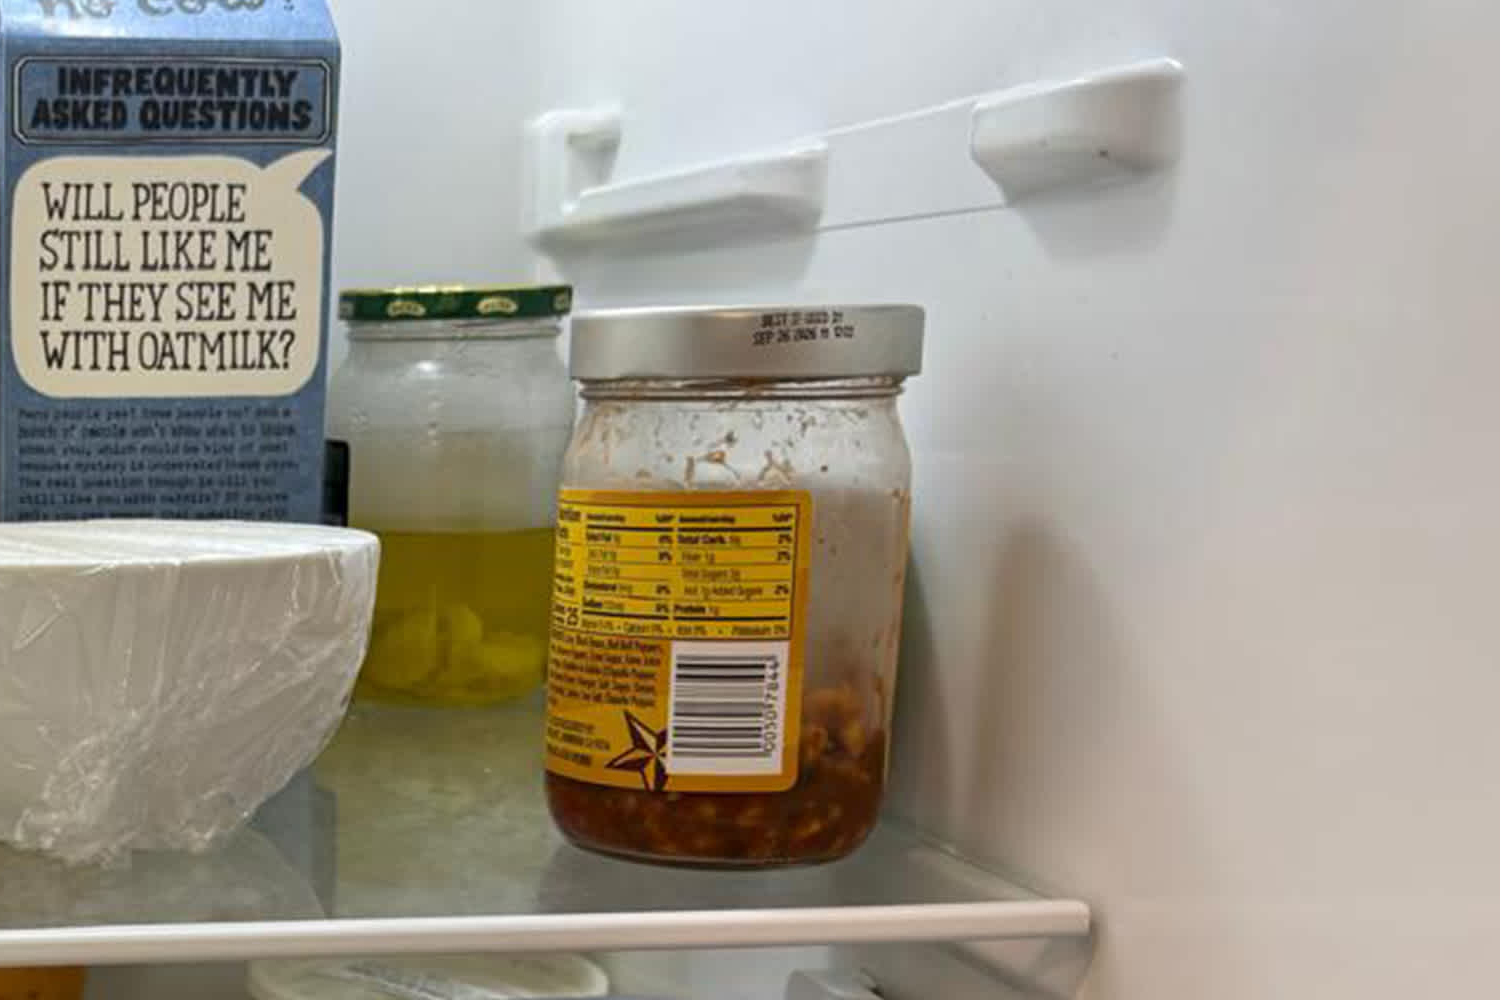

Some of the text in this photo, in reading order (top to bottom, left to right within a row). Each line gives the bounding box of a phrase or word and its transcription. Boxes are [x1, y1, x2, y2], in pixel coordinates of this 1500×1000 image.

[57, 66, 300, 98] INFREQUENTLY
[31, 99, 312, 131] ASKED QUESTIONS
[41, 182, 247, 223] WILL PEOPLE
[39, 229, 130, 272] STILL
[140, 229, 217, 272] LIKE
[225, 229, 273, 272] ME
[40, 280, 297, 322] IF THEY SEE ME
[40, 329, 296, 372] WITH OATMILK?
